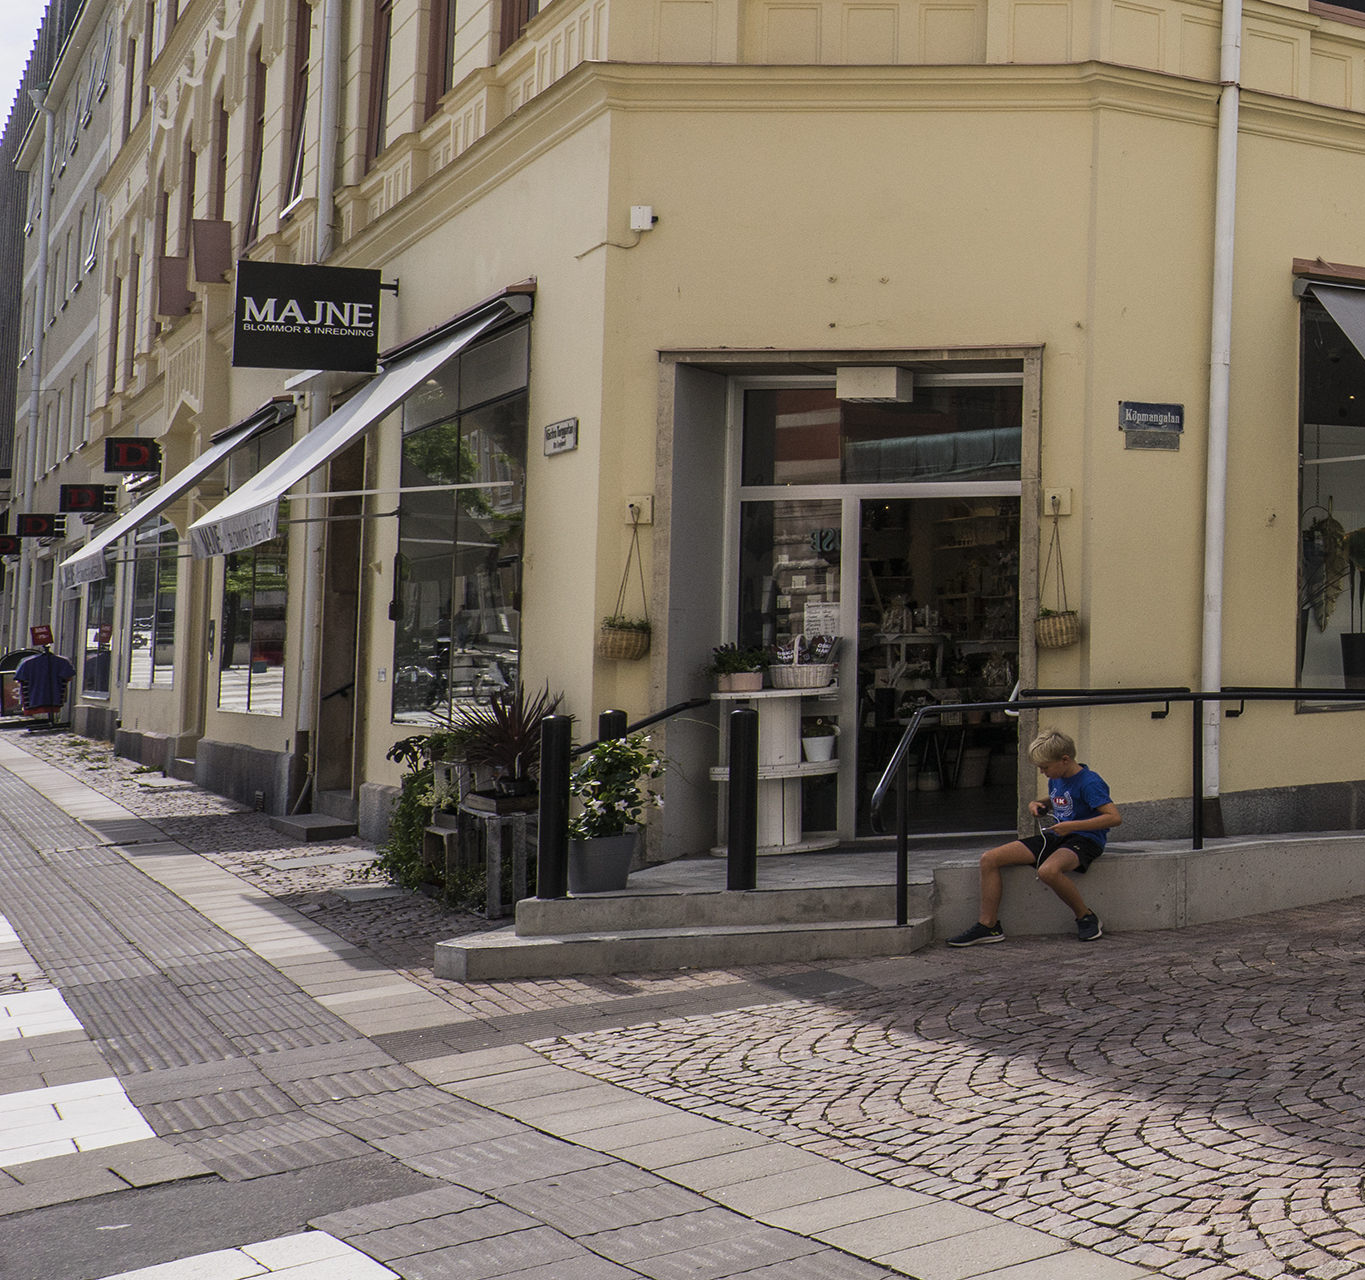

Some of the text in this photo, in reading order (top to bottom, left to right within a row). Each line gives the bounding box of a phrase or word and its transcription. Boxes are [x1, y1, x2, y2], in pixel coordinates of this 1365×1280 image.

[242, 296, 374, 328] MAJNE
[243, 323, 301, 333] BLOMMOR
[314, 327, 375, 337] INREDNING
[1125, 408, 1180, 425] Köpmangatan
[116, 443, 149, 466] D
[68, 489, 96, 507] D
[24, 517, 48, 533] D
